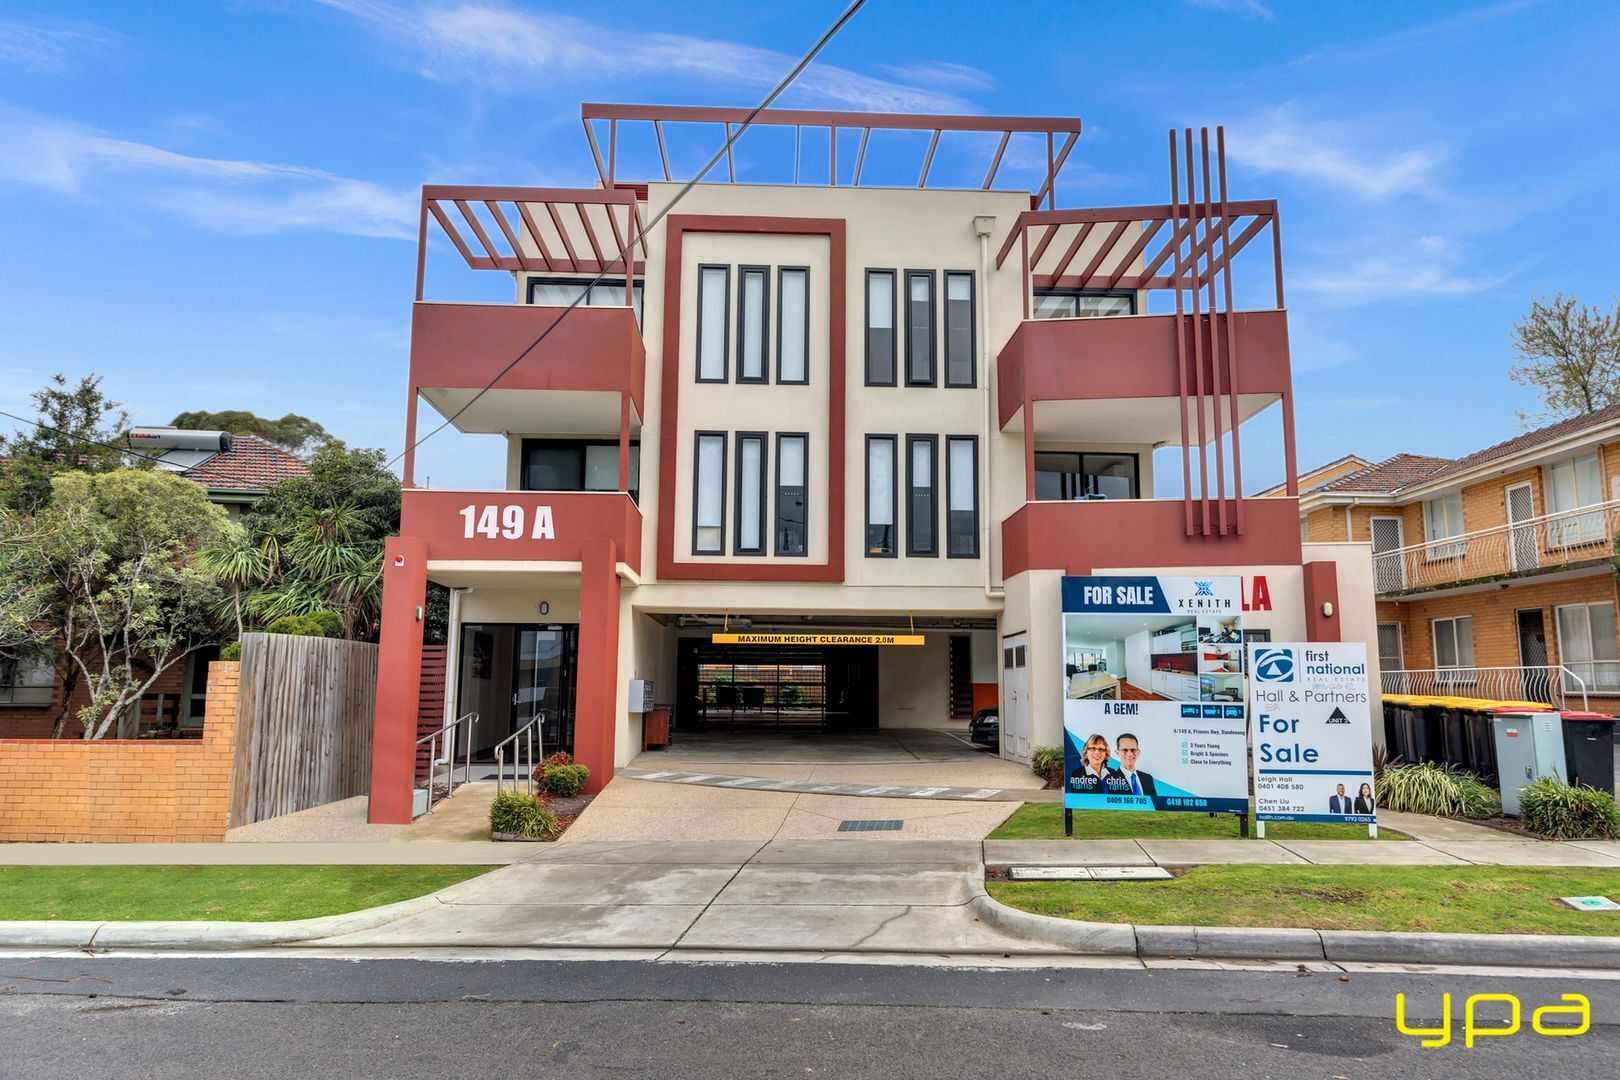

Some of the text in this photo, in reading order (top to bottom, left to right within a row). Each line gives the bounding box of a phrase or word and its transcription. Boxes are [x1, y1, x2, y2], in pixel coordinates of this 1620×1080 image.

[459, 505, 555, 539] 149 A
[1084, 586, 1154, 605] FOR SALE
[1178, 599, 1231, 608] XENITH
[737, 635, 782, 643] MAXIMUM
[820, 636, 873, 644] CLEARANCE
[1305, 650, 1329, 661] first
[1306, 663, 1365, 675] national
[1256, 690, 1367, 703] Hall & Partners
[1104, 703, 1139, 715] A GEM!
[1259, 714, 1300, 733] For
[1260, 743, 1319, 763] Sale
[1070, 775, 1127, 785] andree chris
